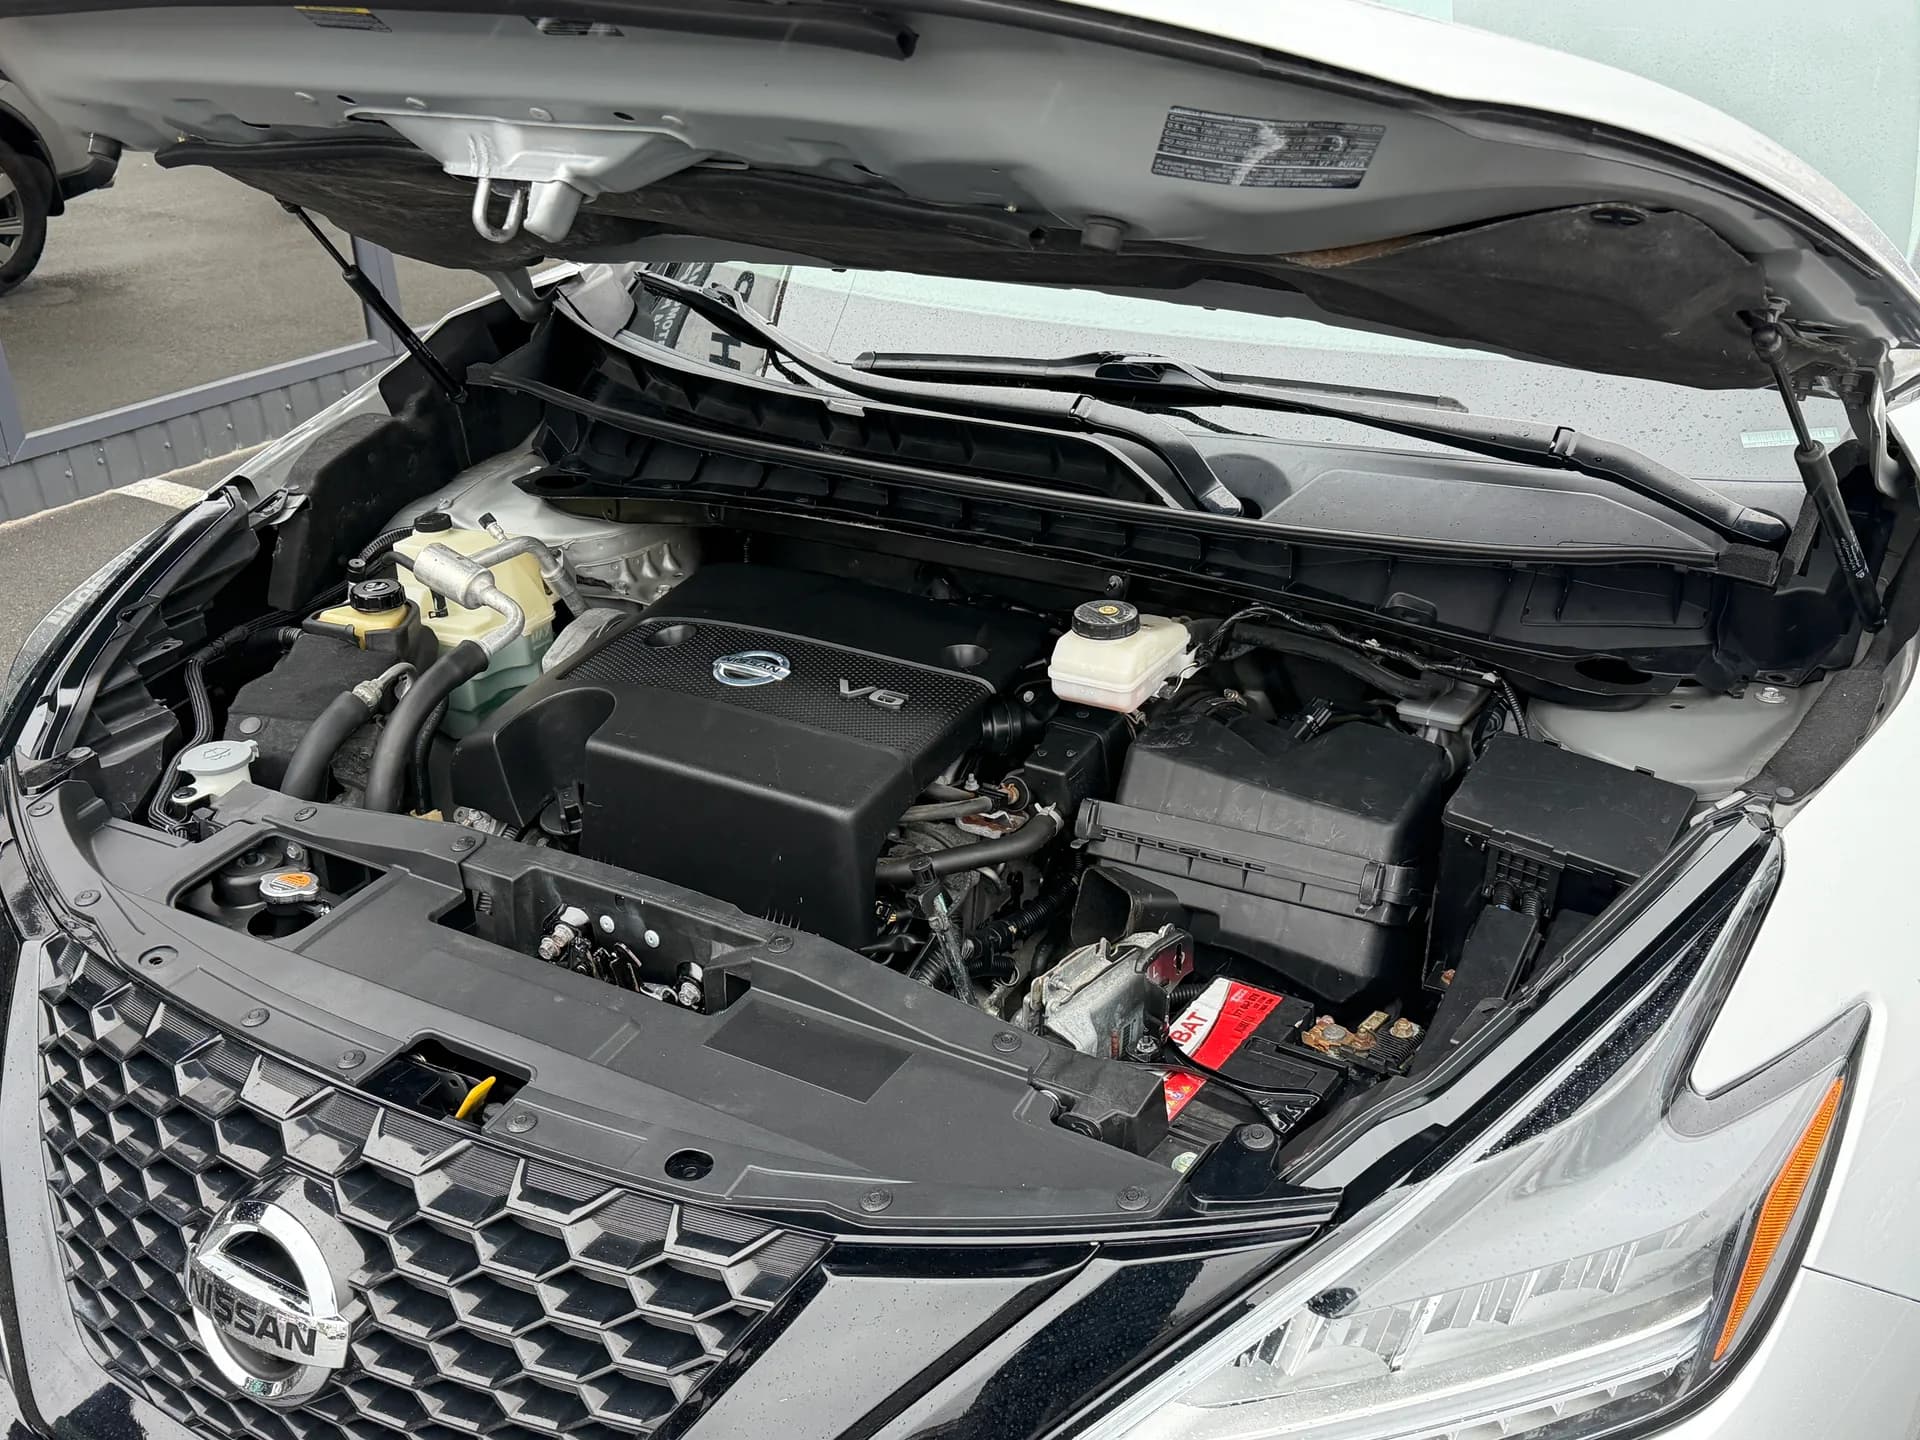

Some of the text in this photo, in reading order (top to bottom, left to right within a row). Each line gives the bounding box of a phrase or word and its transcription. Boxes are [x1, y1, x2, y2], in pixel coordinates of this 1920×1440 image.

[723, 656, 782, 674] NISSAN
[839, 678, 909, 710] V6
[1170, 1011, 1209, 1047] BAT
[189, 1268, 317, 1357] NISSAN
